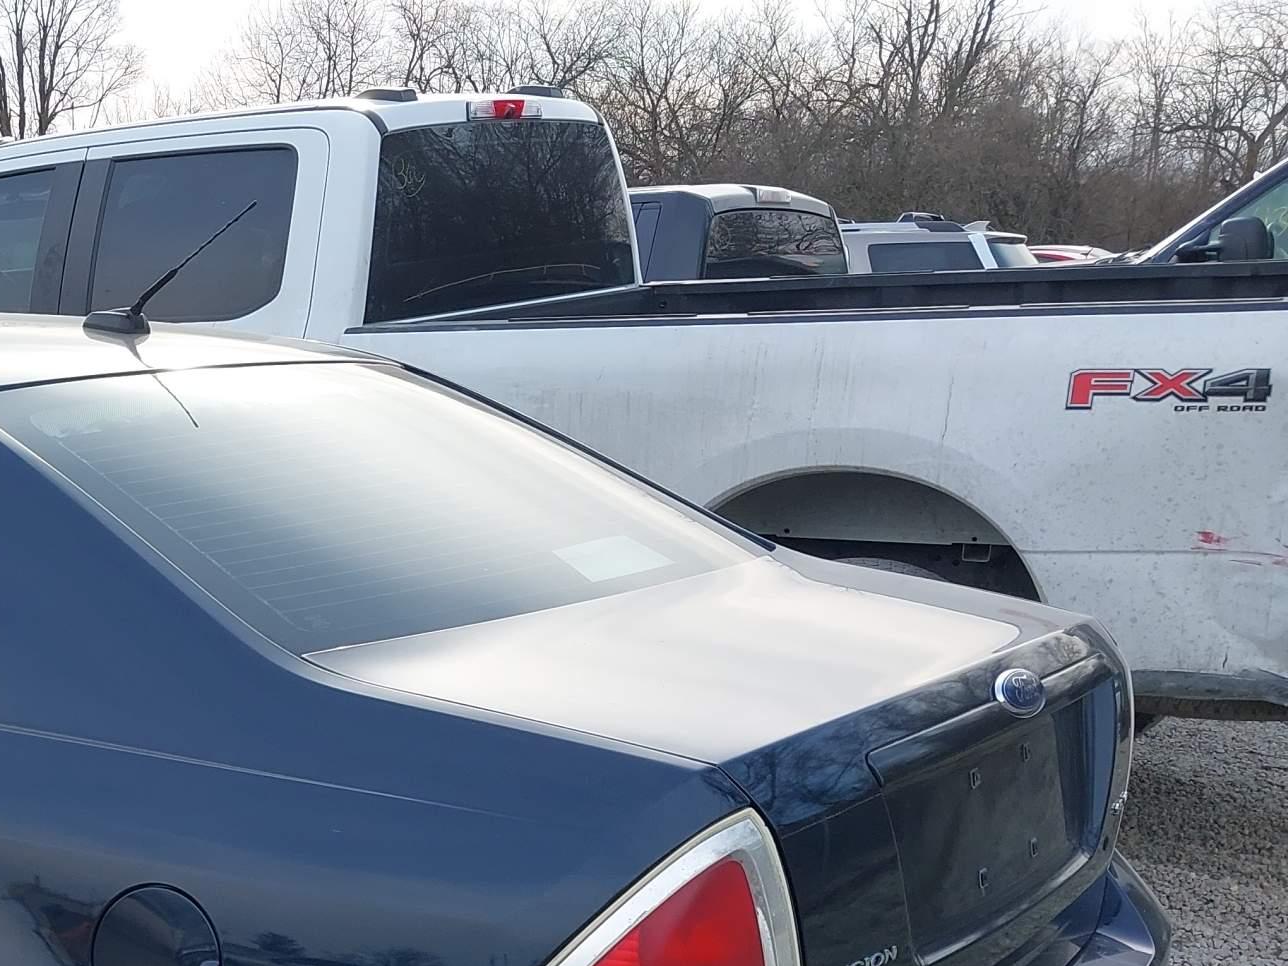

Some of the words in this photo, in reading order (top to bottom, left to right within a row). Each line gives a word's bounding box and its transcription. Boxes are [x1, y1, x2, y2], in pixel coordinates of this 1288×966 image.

[1065, 368, 1273, 410] FX4
[1174, 404, 1210, 413] OFF
[1216, 404, 1267, 413] ROAD
